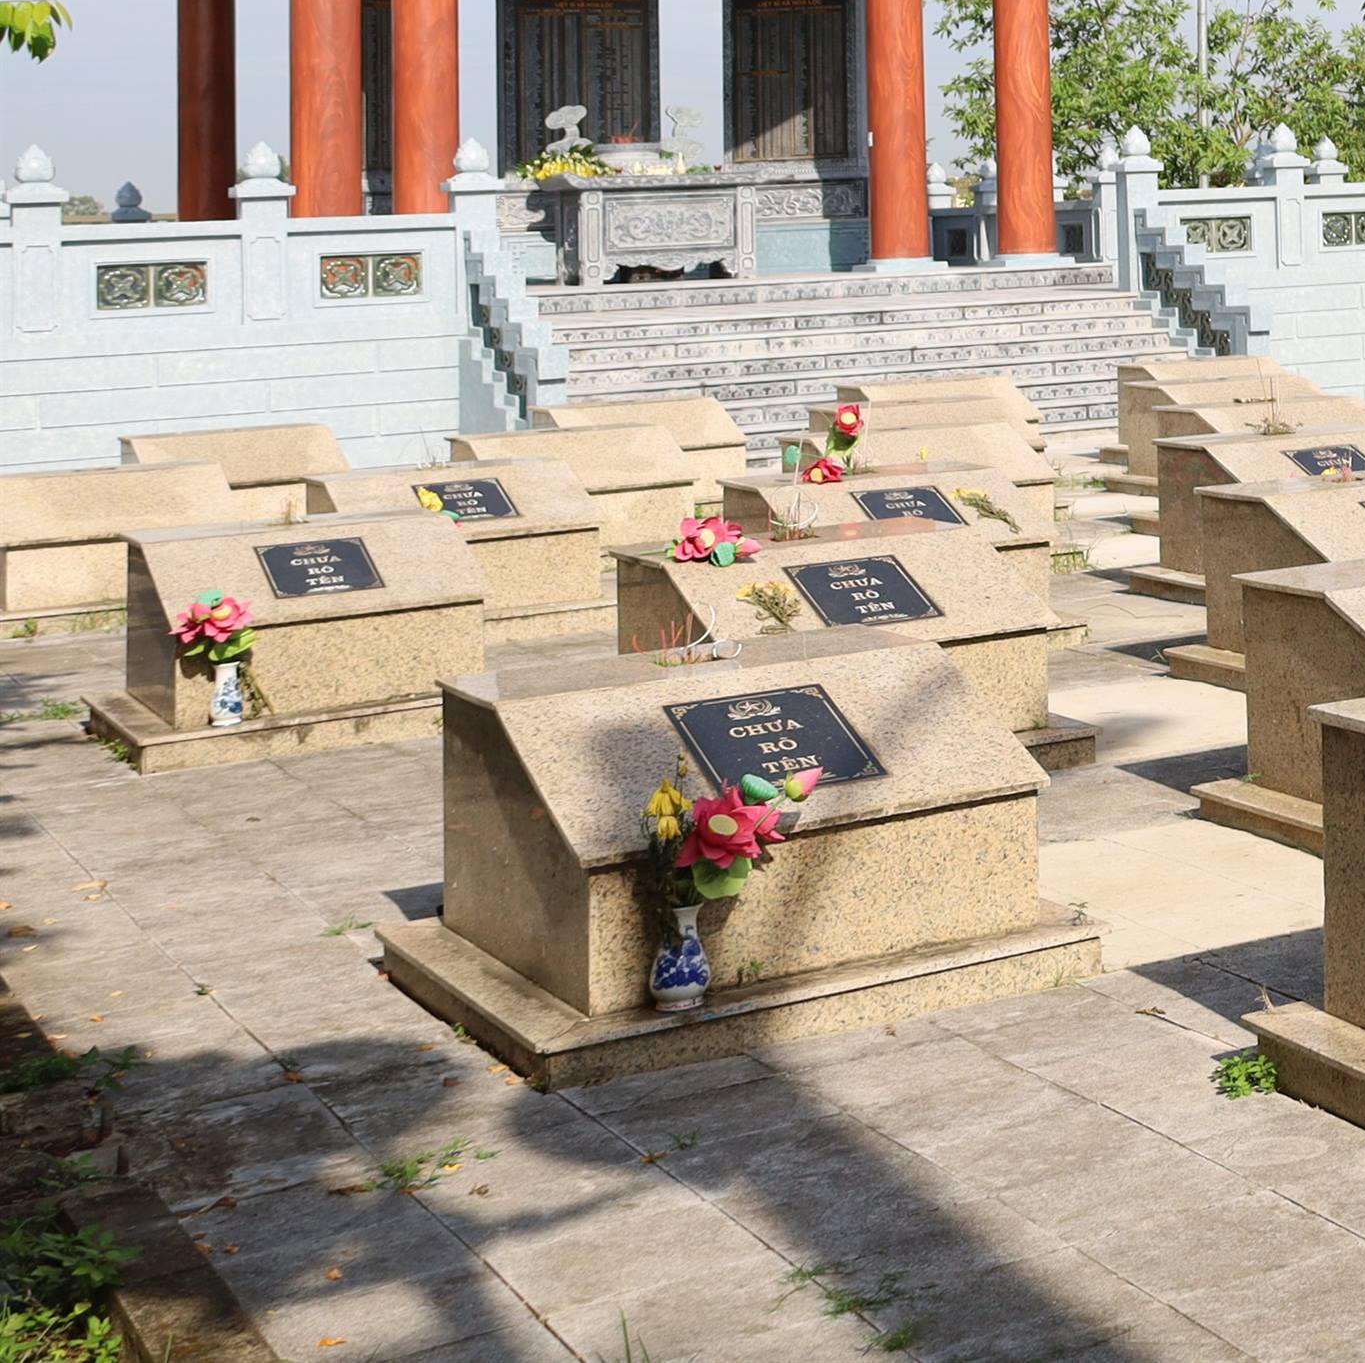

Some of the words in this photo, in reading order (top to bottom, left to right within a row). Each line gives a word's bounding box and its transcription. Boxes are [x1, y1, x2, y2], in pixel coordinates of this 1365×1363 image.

[830, 576, 883, 590] CHƯA
[855, 601, 895, 614] TÊN
[729, 718, 804, 738] CHƯA
[762, 755, 820, 774] TÊN
